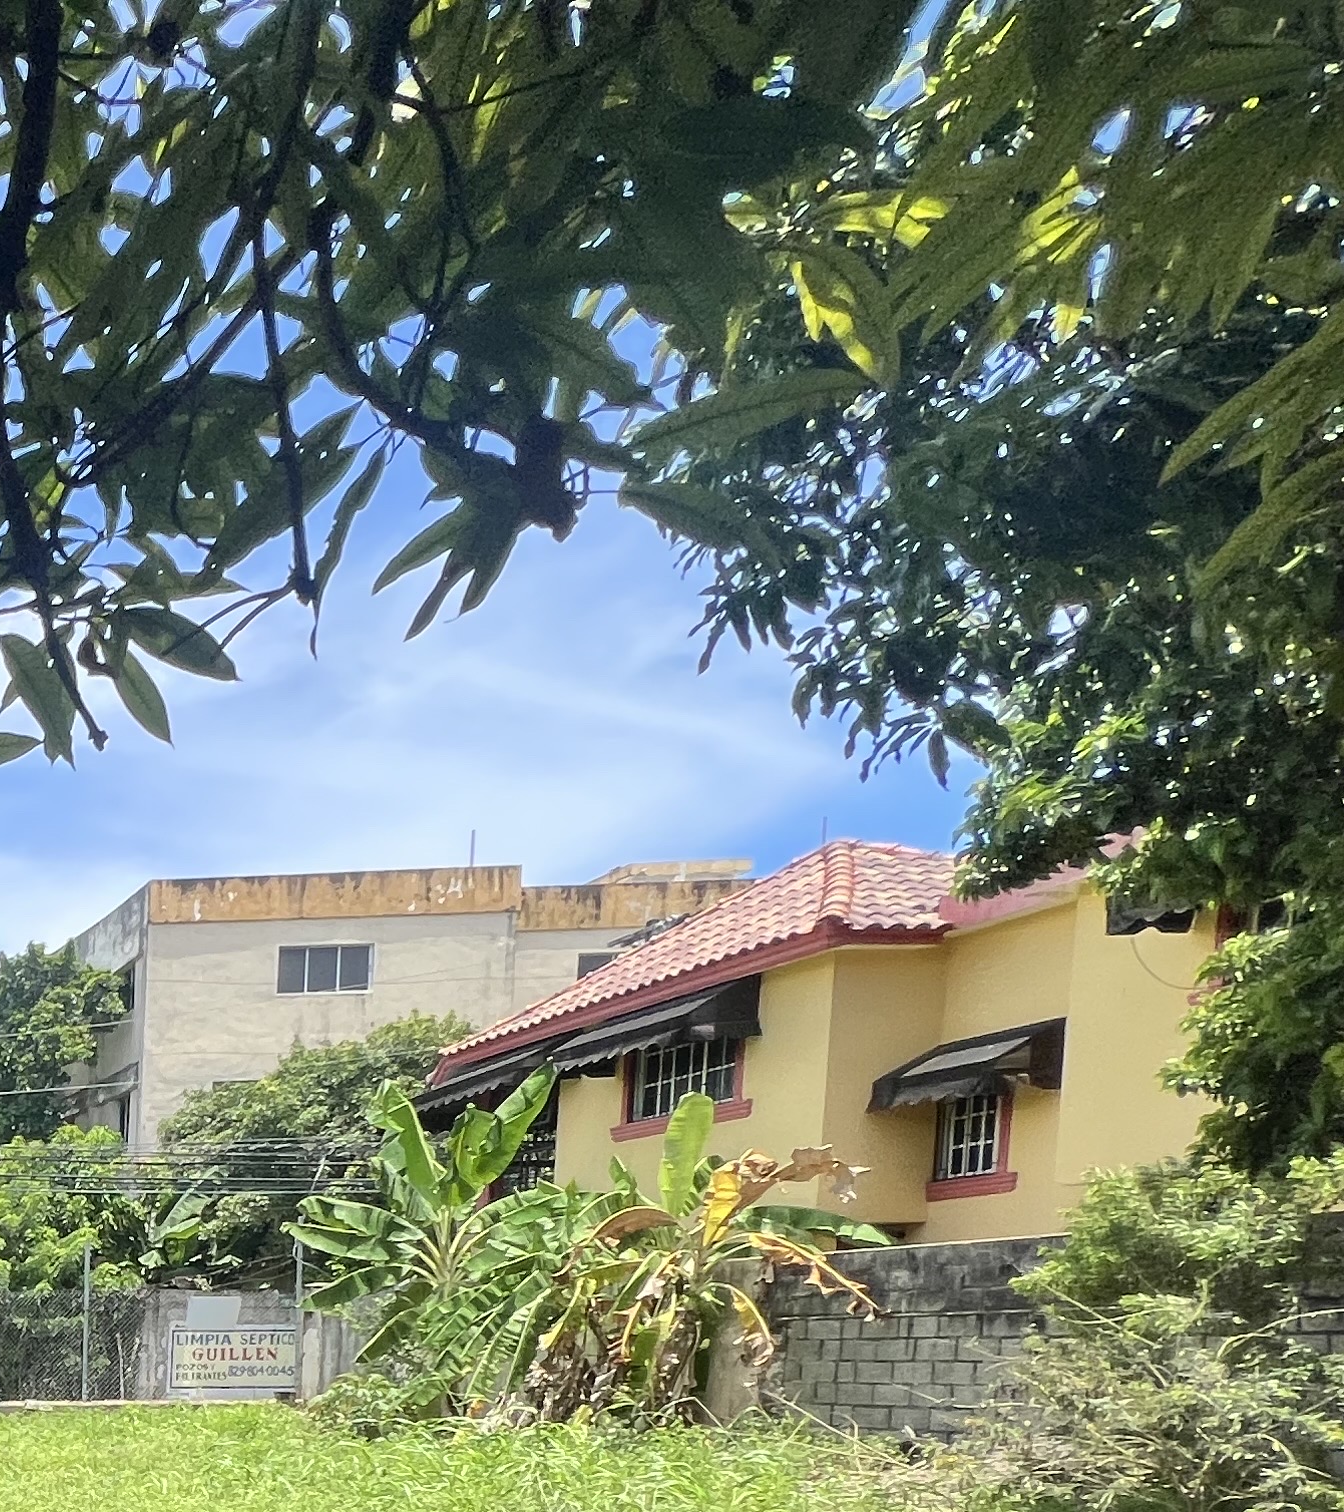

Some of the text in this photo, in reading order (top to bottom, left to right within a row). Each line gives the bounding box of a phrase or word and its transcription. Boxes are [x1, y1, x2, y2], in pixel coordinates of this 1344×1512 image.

[176, 1333, 232, 1346] LIMPIA
[192, 1347, 278, 1361] GUILLEN
[175, 1363, 209, 1371] POZOS
[175, 1371, 227, 1381] FILTRANTES
